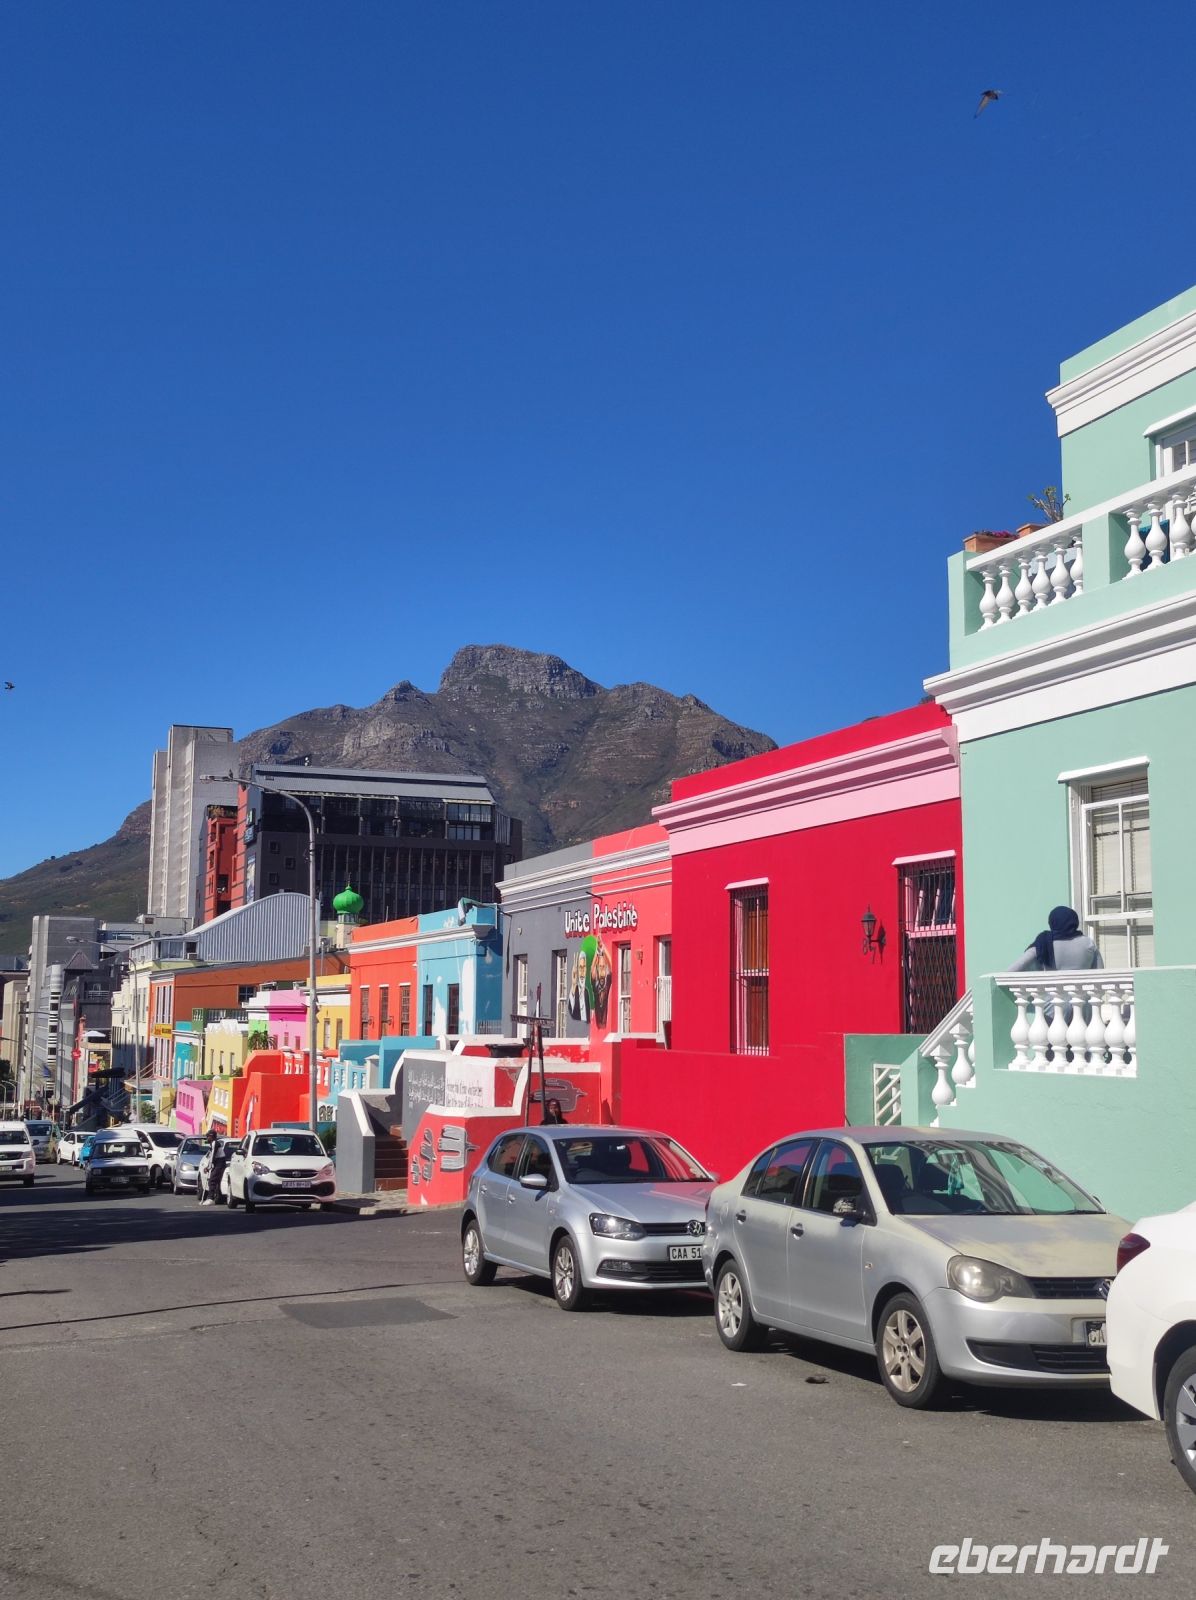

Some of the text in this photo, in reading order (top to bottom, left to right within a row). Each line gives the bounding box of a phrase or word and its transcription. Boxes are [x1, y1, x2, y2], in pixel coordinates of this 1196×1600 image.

[565, 902, 638, 933] Unite Palestine
[671, 1248, 688, 1259] CAA
